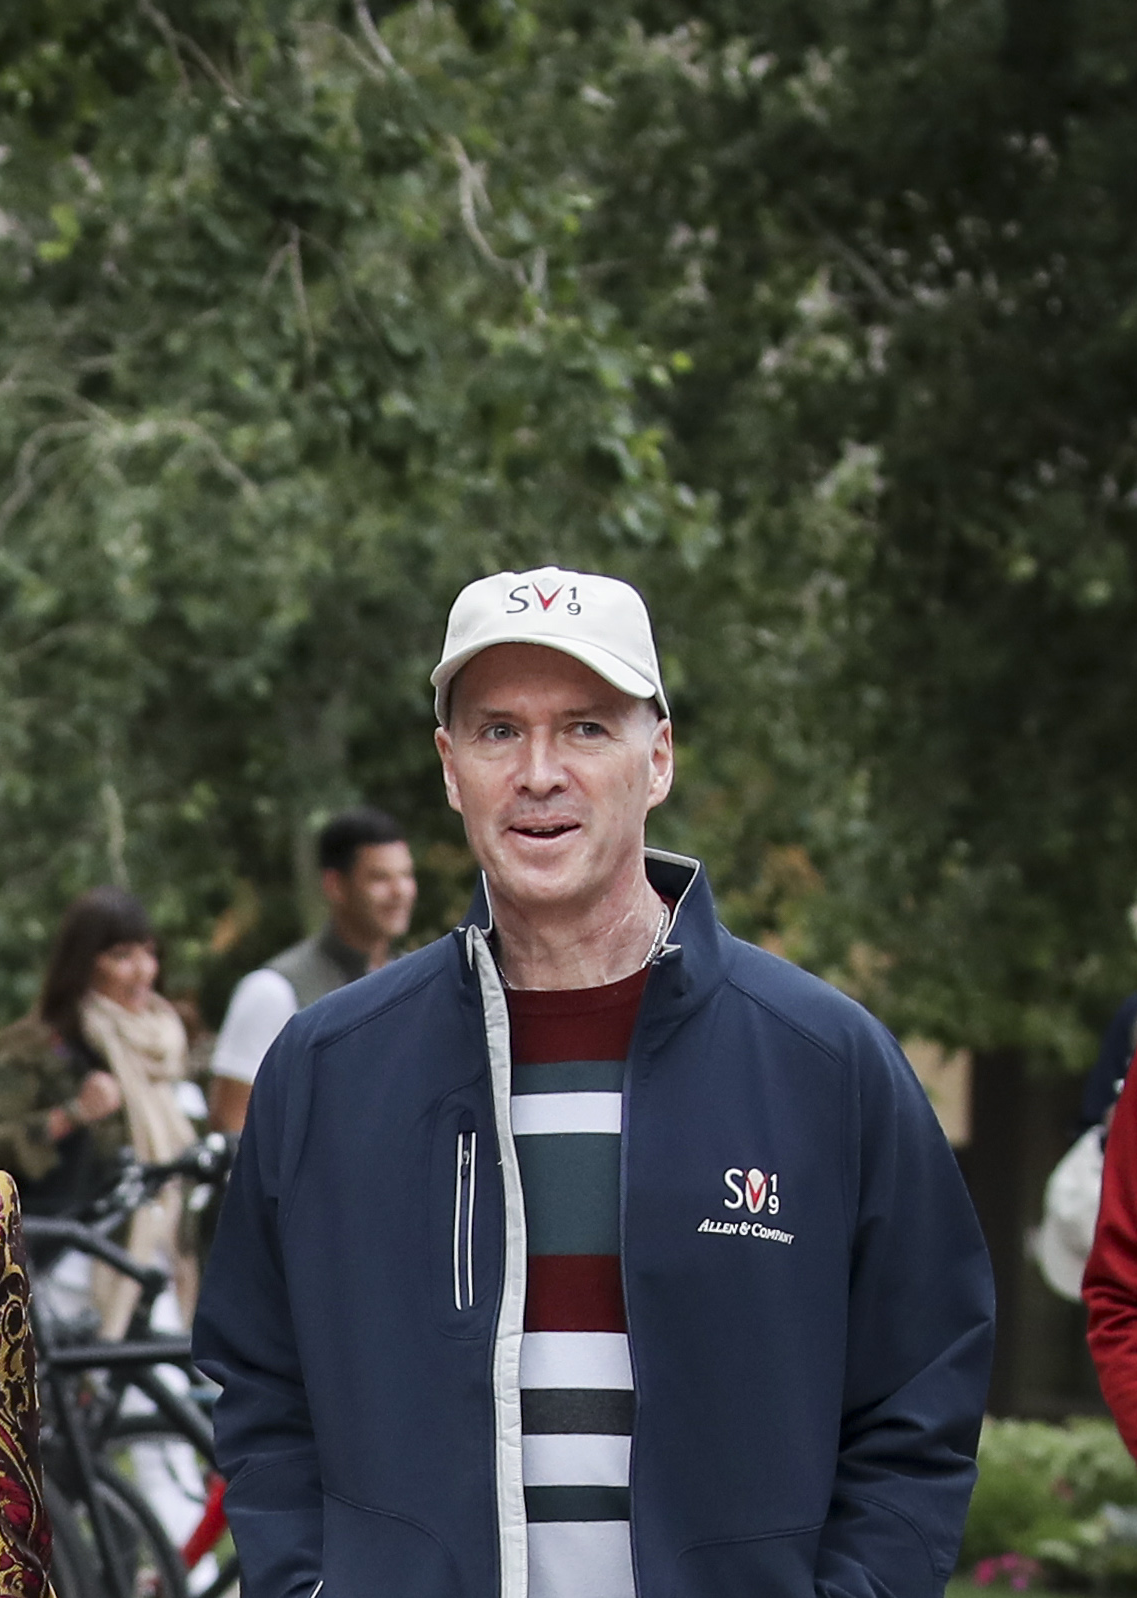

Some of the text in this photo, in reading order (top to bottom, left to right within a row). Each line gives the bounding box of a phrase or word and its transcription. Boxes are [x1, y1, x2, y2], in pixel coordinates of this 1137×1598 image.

[697, 1218, 795, 1245] ALLEN & COMPANY
